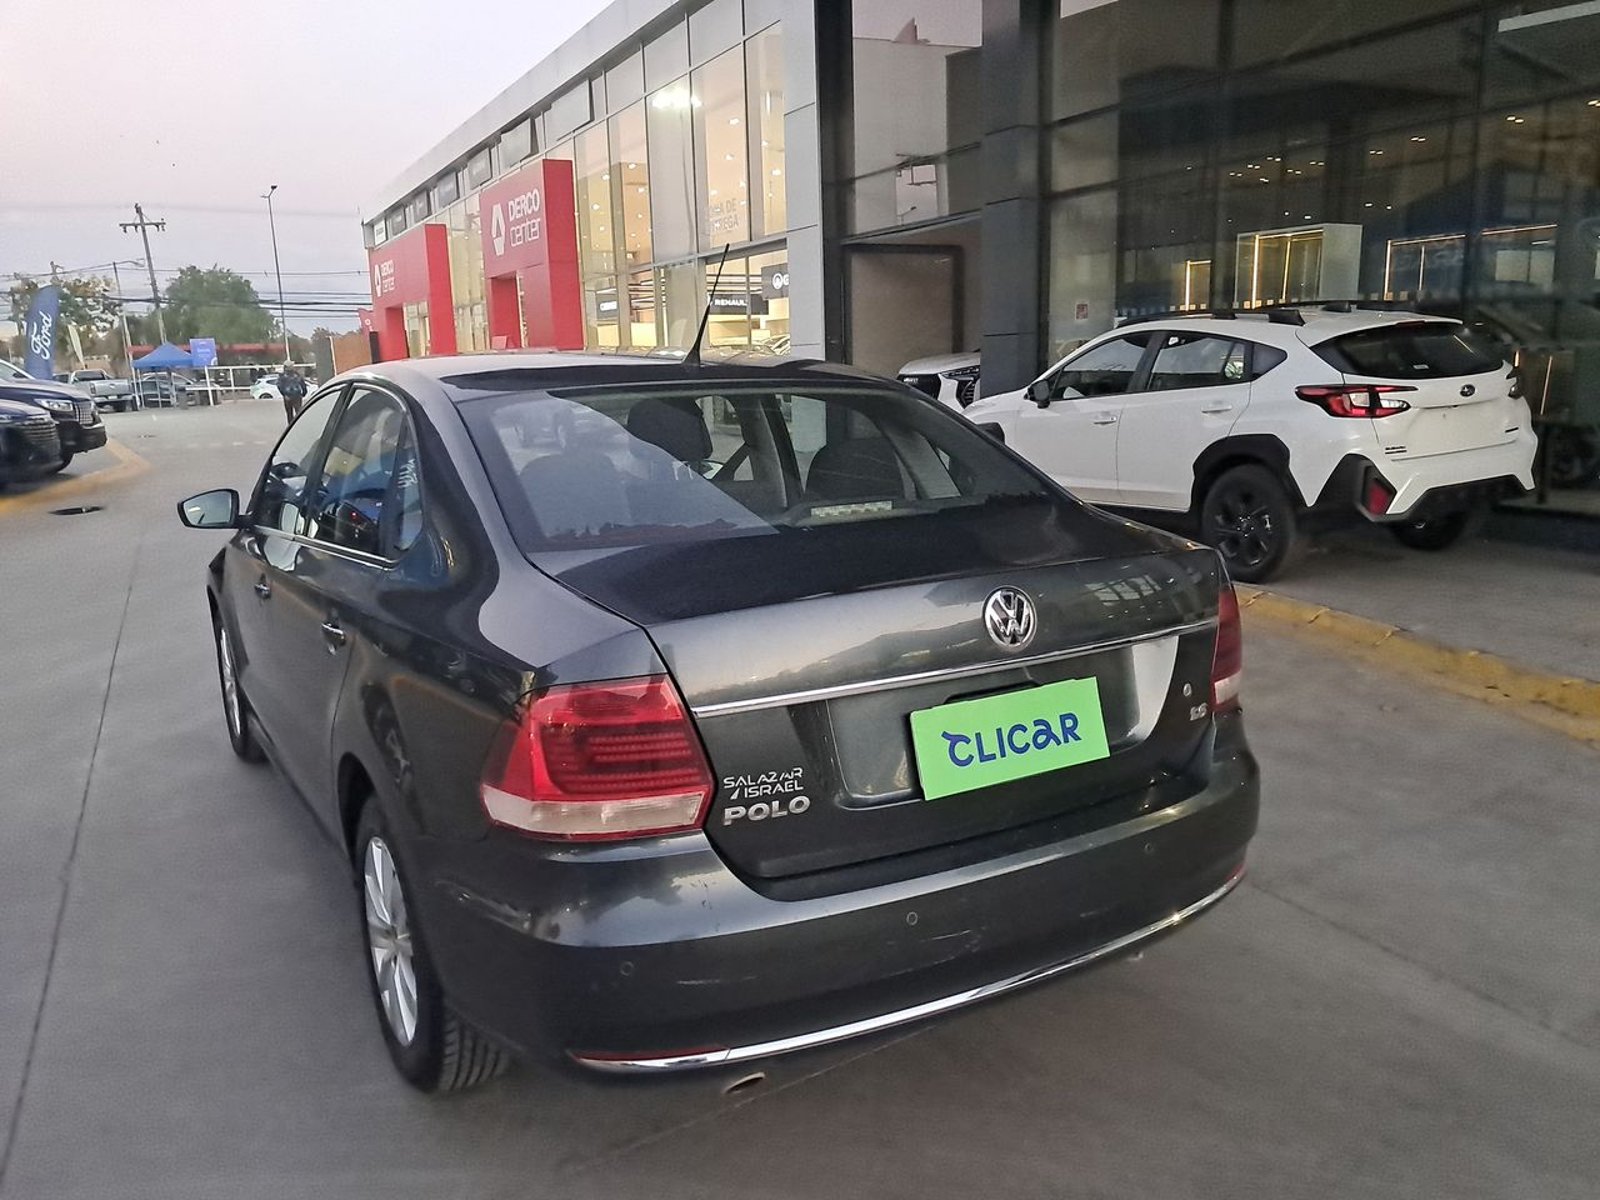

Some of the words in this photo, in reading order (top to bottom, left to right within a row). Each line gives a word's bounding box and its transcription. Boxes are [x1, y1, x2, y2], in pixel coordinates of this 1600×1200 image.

[508, 188, 540, 222] DERCO
[714, 298, 748, 307] RENAUL
[30, 311, 52, 360] Ford
[723, 766, 803, 789] SALAZAR
[744, 779, 804, 799] ISRAEL
[723, 795, 811, 826] POLO
